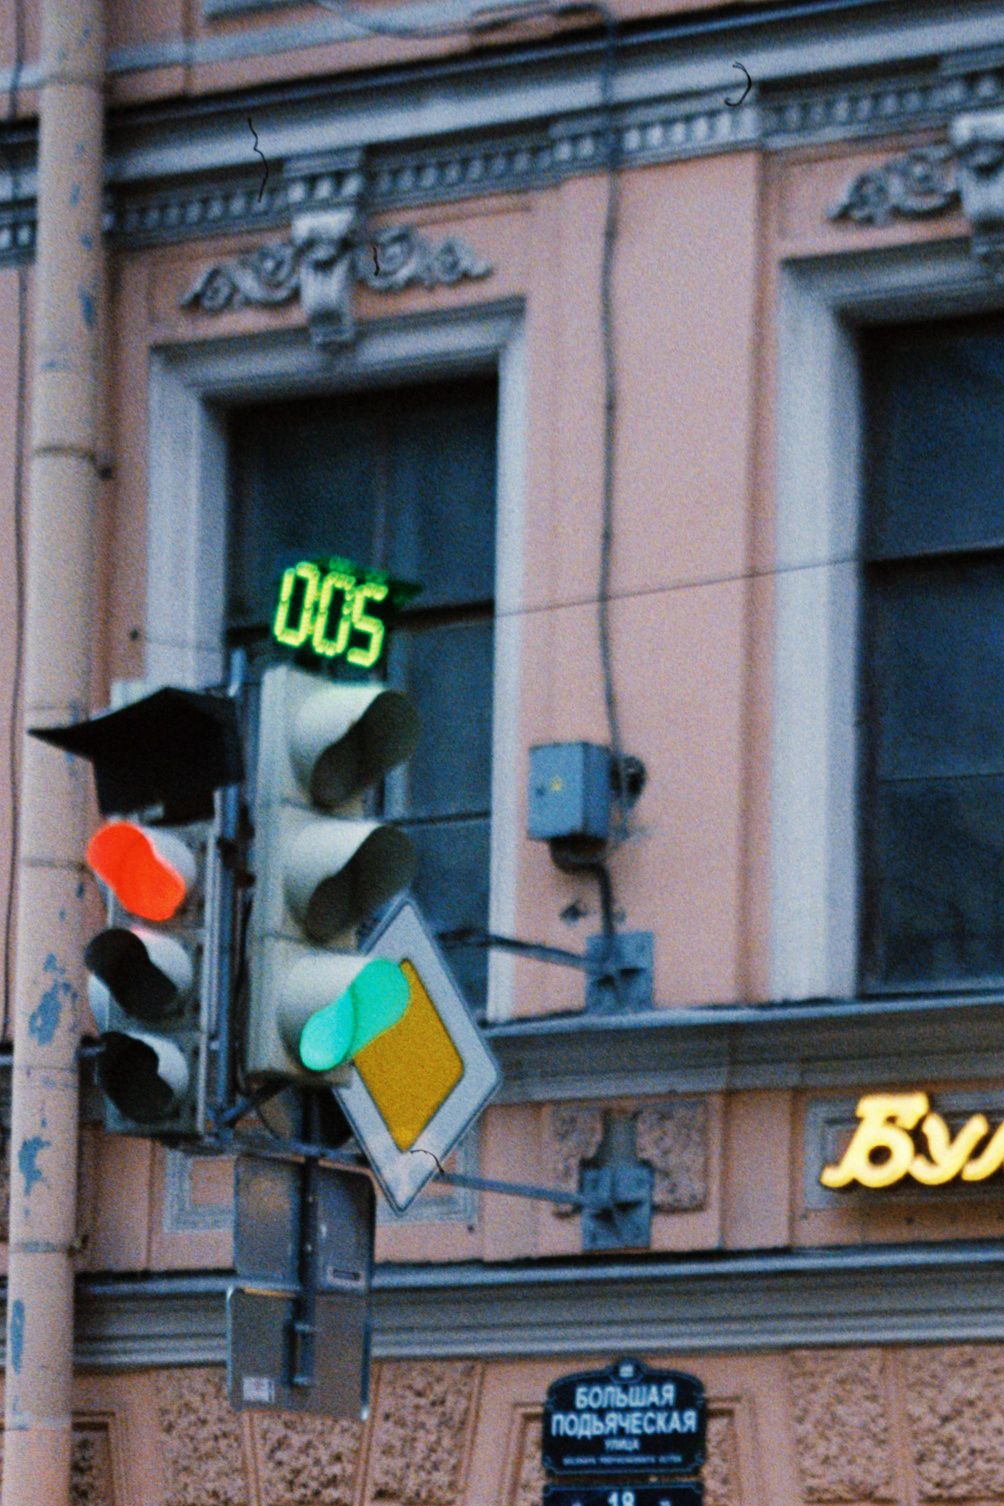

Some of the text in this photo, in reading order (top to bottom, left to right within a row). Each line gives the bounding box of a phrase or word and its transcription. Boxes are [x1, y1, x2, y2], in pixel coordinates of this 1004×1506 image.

[273, 560, 389, 669] 005
[575, 1383, 675, 1409] БОЛЬШАЯ
[551, 1410, 698, 1439] ПОДЬЯЧЕСКАЯ
